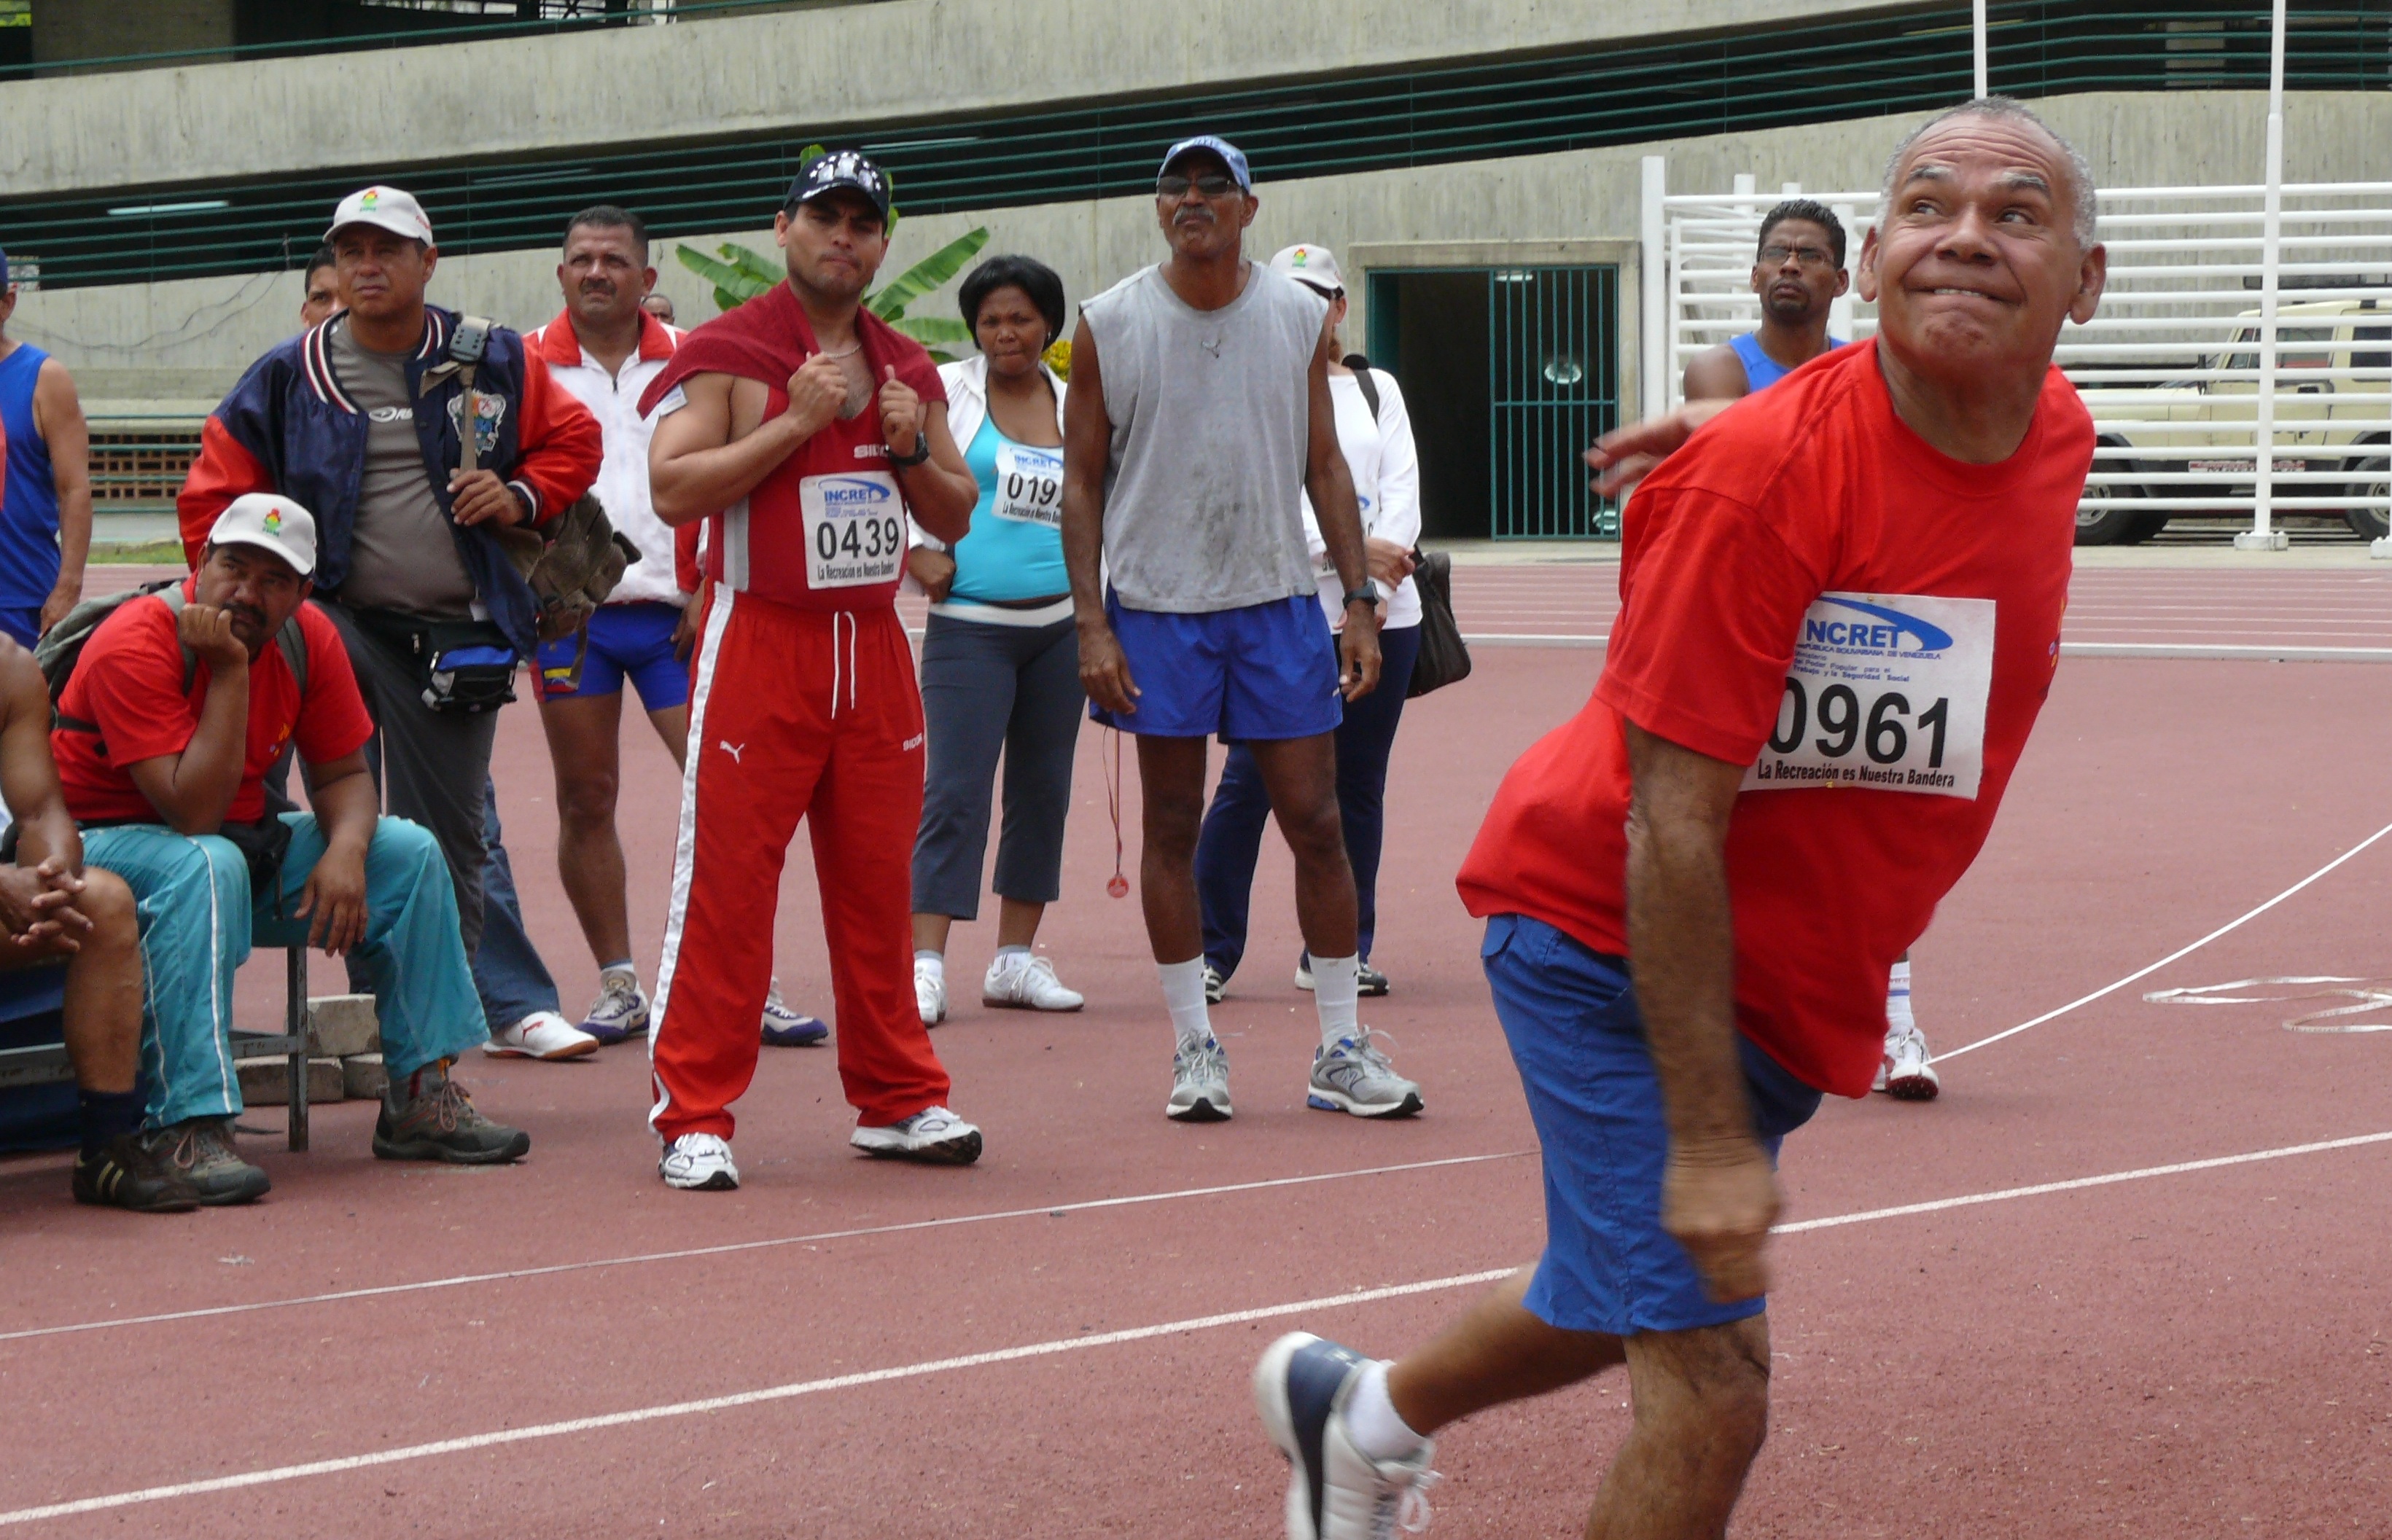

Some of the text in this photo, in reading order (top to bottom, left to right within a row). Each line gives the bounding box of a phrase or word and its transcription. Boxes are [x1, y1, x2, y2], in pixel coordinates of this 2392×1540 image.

[825, 488, 872, 501] INCRET
[1008, 472, 1062, 508] 019
[817, 517, 899, 560] 0439
[1806, 618, 1899, 648] NCRET
[1831, 662, 1858, 671] Popular
[1899, 652, 1941, 660] VENEZUELA
[1842, 671, 1881, 681] Seguridad
[1887, 674, 1910, 682] Social
[1767, 676, 1949, 769] 0961
[1758, 759, 1955, 788] La Recreación es Nuestra Bandera
